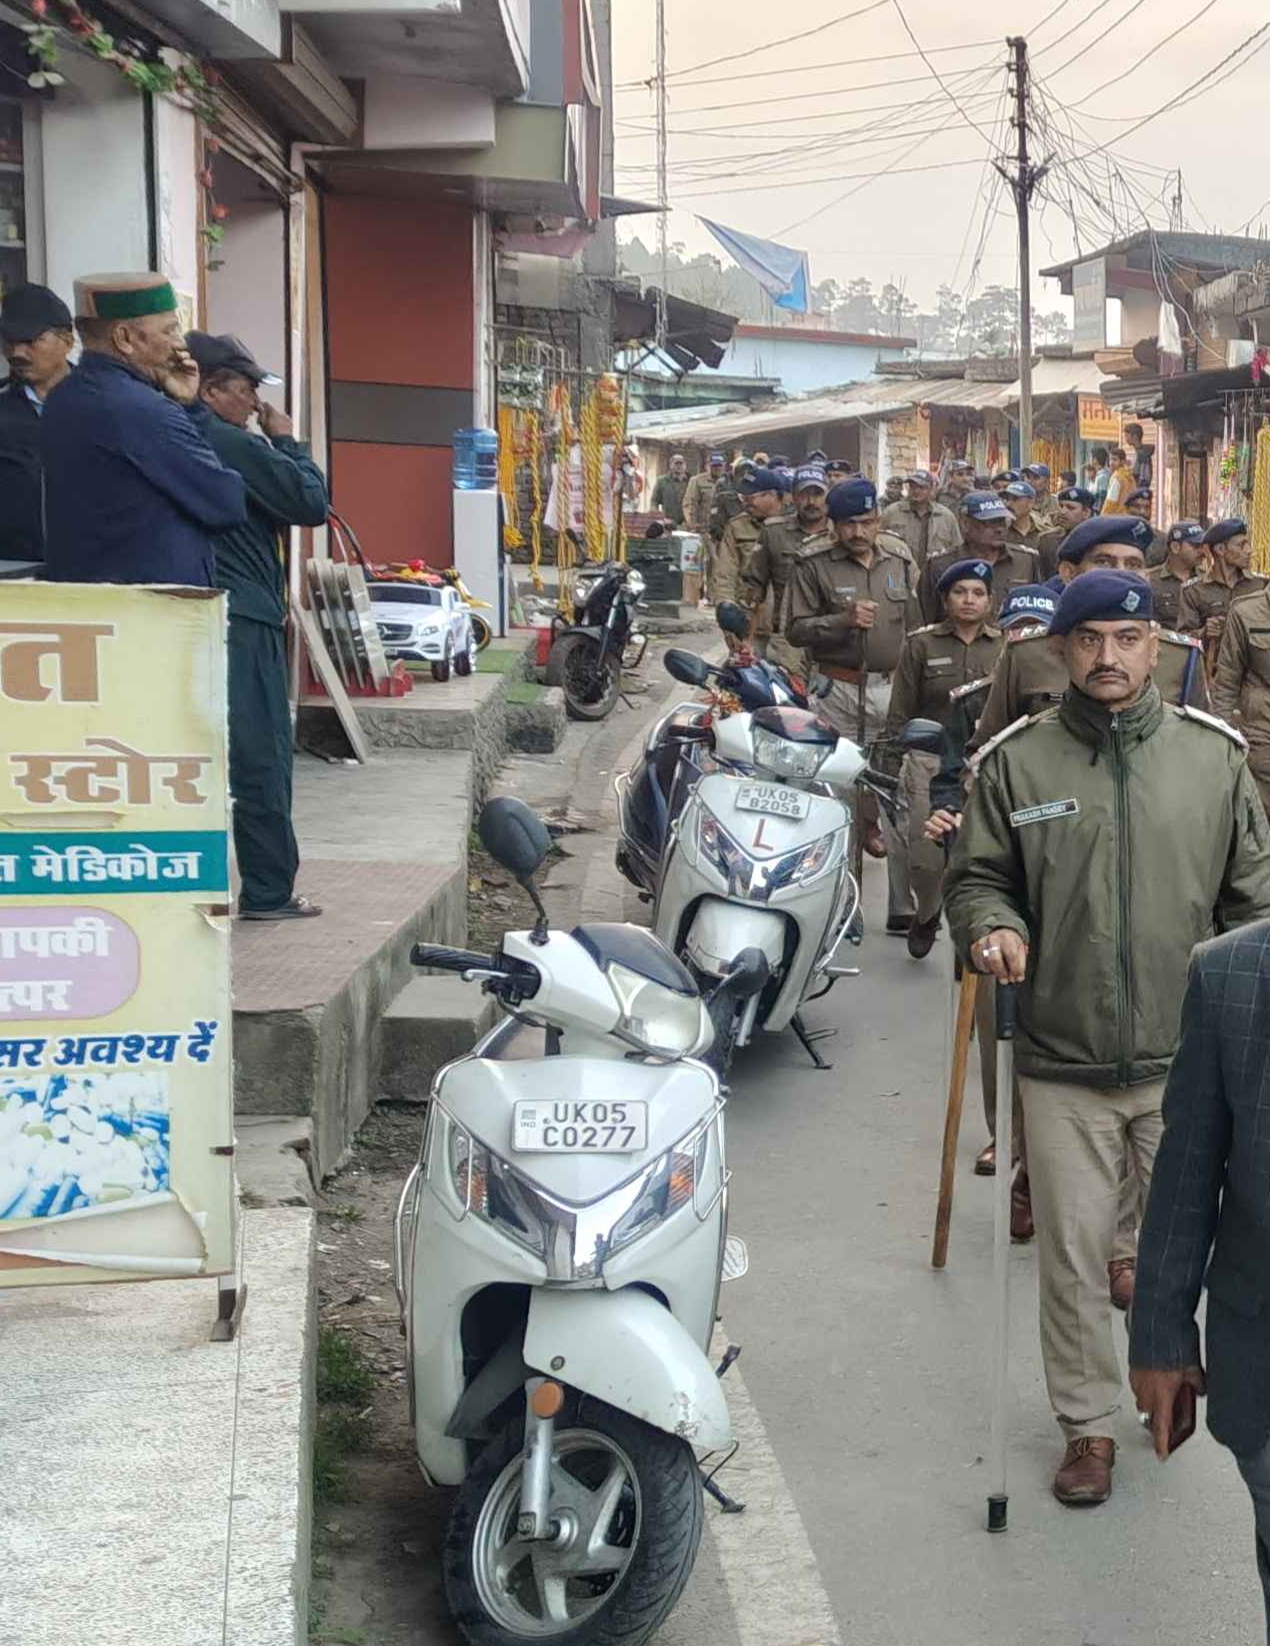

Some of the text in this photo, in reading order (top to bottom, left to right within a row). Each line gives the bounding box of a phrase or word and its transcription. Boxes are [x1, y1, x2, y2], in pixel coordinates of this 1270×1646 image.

[1009, 595, 1054, 611] POLICE
[10, 737, 212, 804] स्टोर
[753, 819, 774, 850] L
[30, 843, 202, 882] मेडिकोज
[54, 1034, 181, 1065] अवश्य
[187, 1021, 218, 1062] दें
[553, 1102, 627, 1124] UK05
[543, 1126, 636, 1148] C0277
